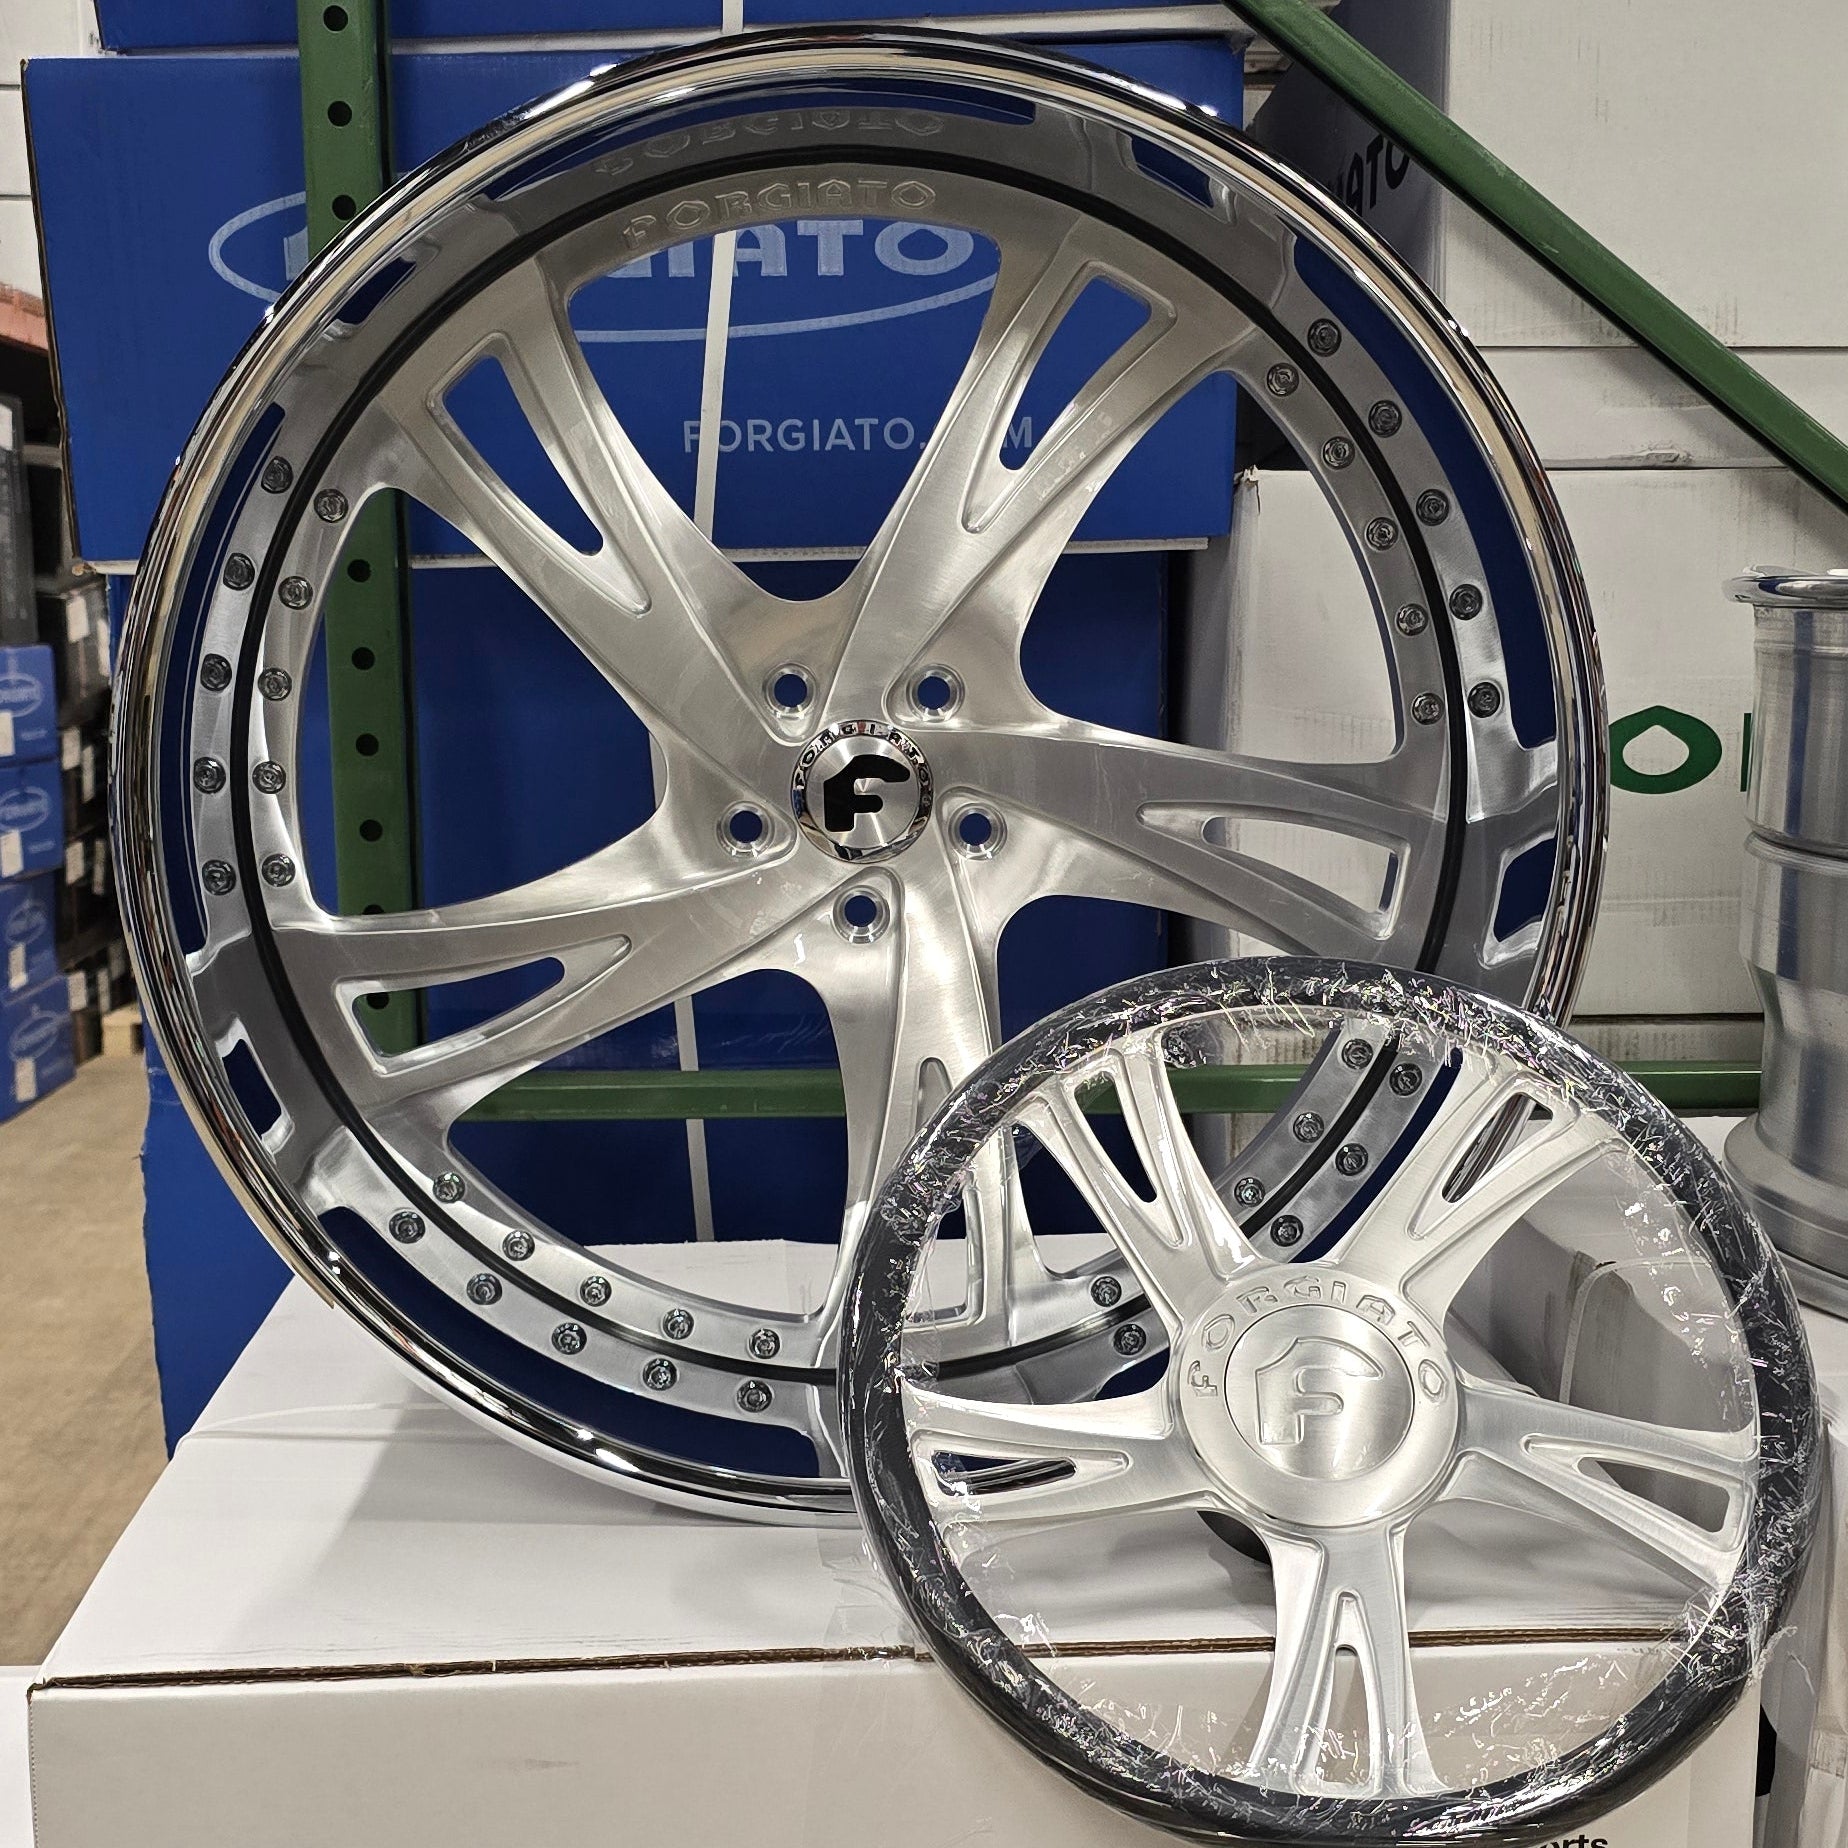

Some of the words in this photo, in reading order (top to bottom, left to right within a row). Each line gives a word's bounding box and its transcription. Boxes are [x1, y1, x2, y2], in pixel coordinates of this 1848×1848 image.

[623, 178, 937, 250] FORGIATO
[1337, 132, 1411, 217] ATO
[683, 416, 1033, 453] FORGIATO.M
[823, 754, 911, 833] F
[1187, 1274, 1447, 1403] FORGIATO
[1254, 1335, 1385, 1446] F
